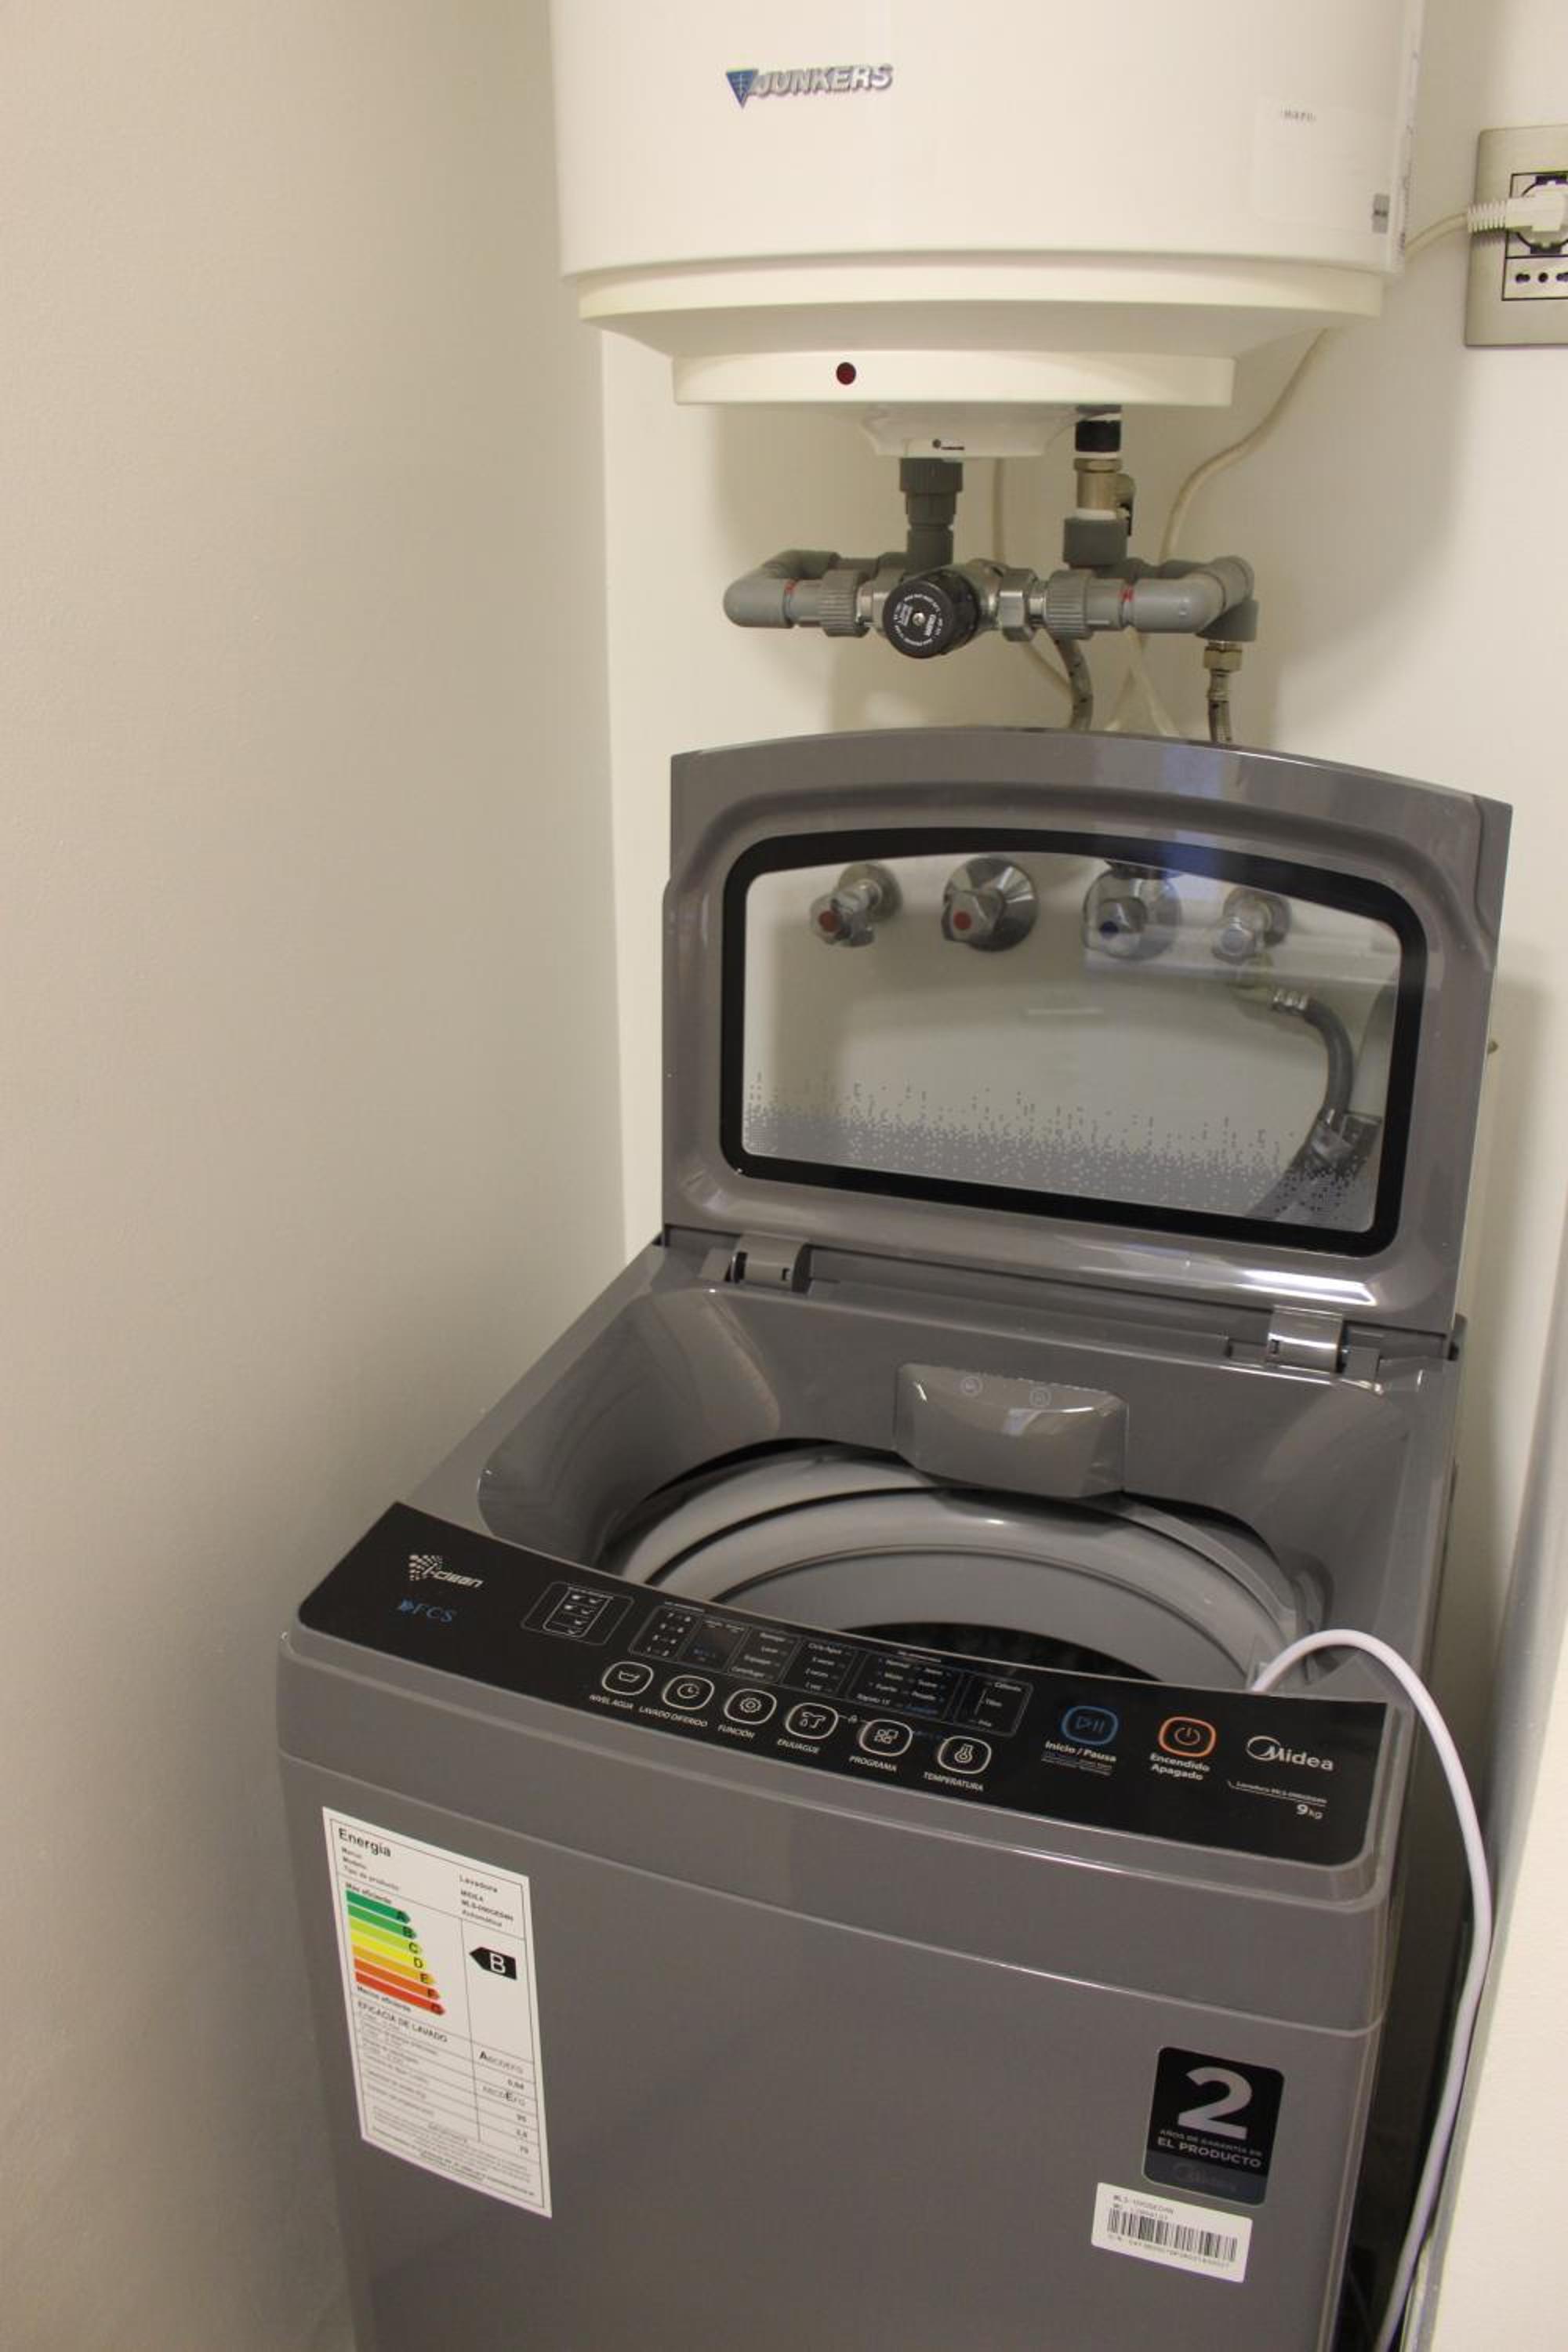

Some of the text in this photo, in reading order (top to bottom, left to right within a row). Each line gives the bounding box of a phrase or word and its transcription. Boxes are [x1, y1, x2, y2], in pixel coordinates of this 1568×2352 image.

[749, 63, 894, 98] JUNKERS
[1044, 1740, 1076, 1755] Inicio
[1083, 1748, 1117, 1763] Pausa
[1149, 1751, 1211, 1773] Encendido
[1245, 1735, 1334, 1772] Midea
[848, 1755, 898, 1773] PROGRAMA
[1151, 1763, 1204, 1782] Apagado
[923, 1770, 985, 1792] TEMPERATURA
[408, 1941, 419, 1955] C
[414, 1957, 424, 1969] D
[489, 1950, 506, 1975] B
[419, 1973, 430, 1985] E
[1177, 2065, 1254, 2141] 2
[1157, 2135, 1262, 2169] EL PRODUCTO
